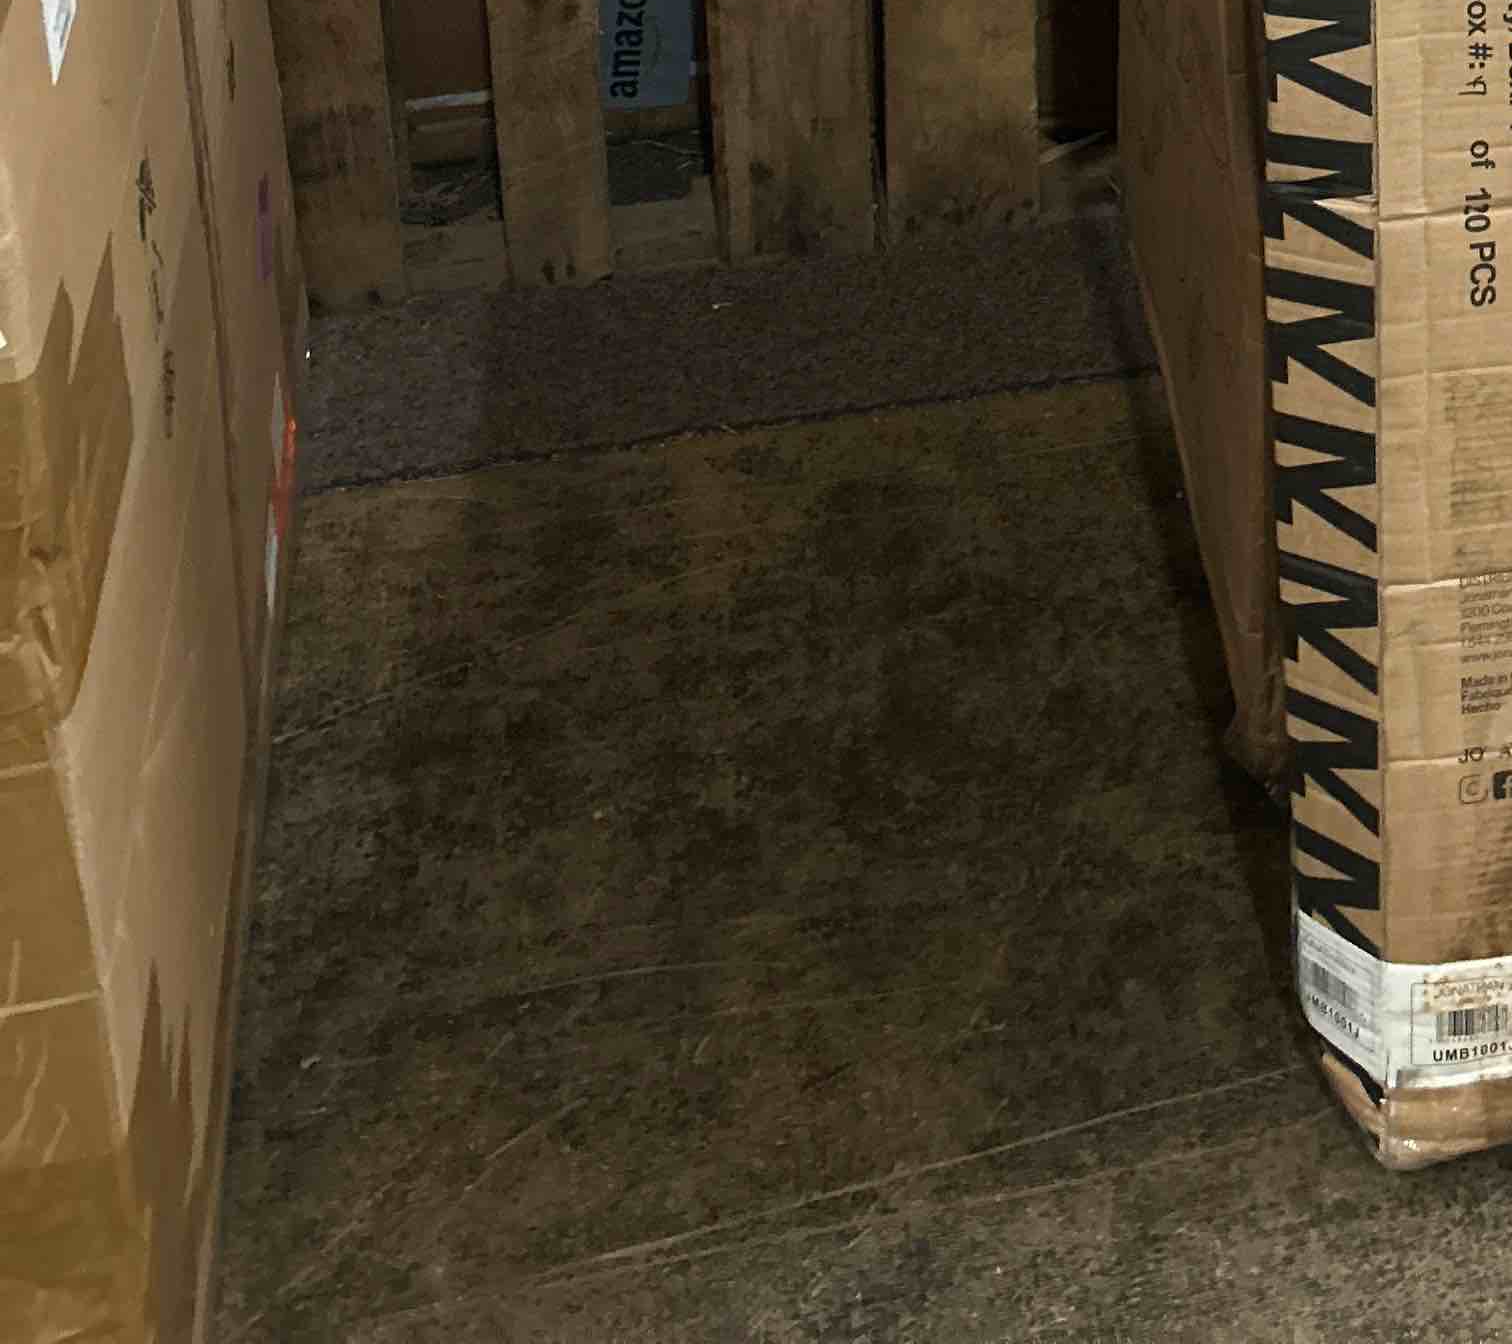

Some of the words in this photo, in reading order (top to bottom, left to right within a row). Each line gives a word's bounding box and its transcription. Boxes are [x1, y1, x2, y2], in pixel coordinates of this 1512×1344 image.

[1470, 140, 1496, 171] of
[1468, 240, 1498, 309] PCS
[1460, 674, 1491, 689] Made
